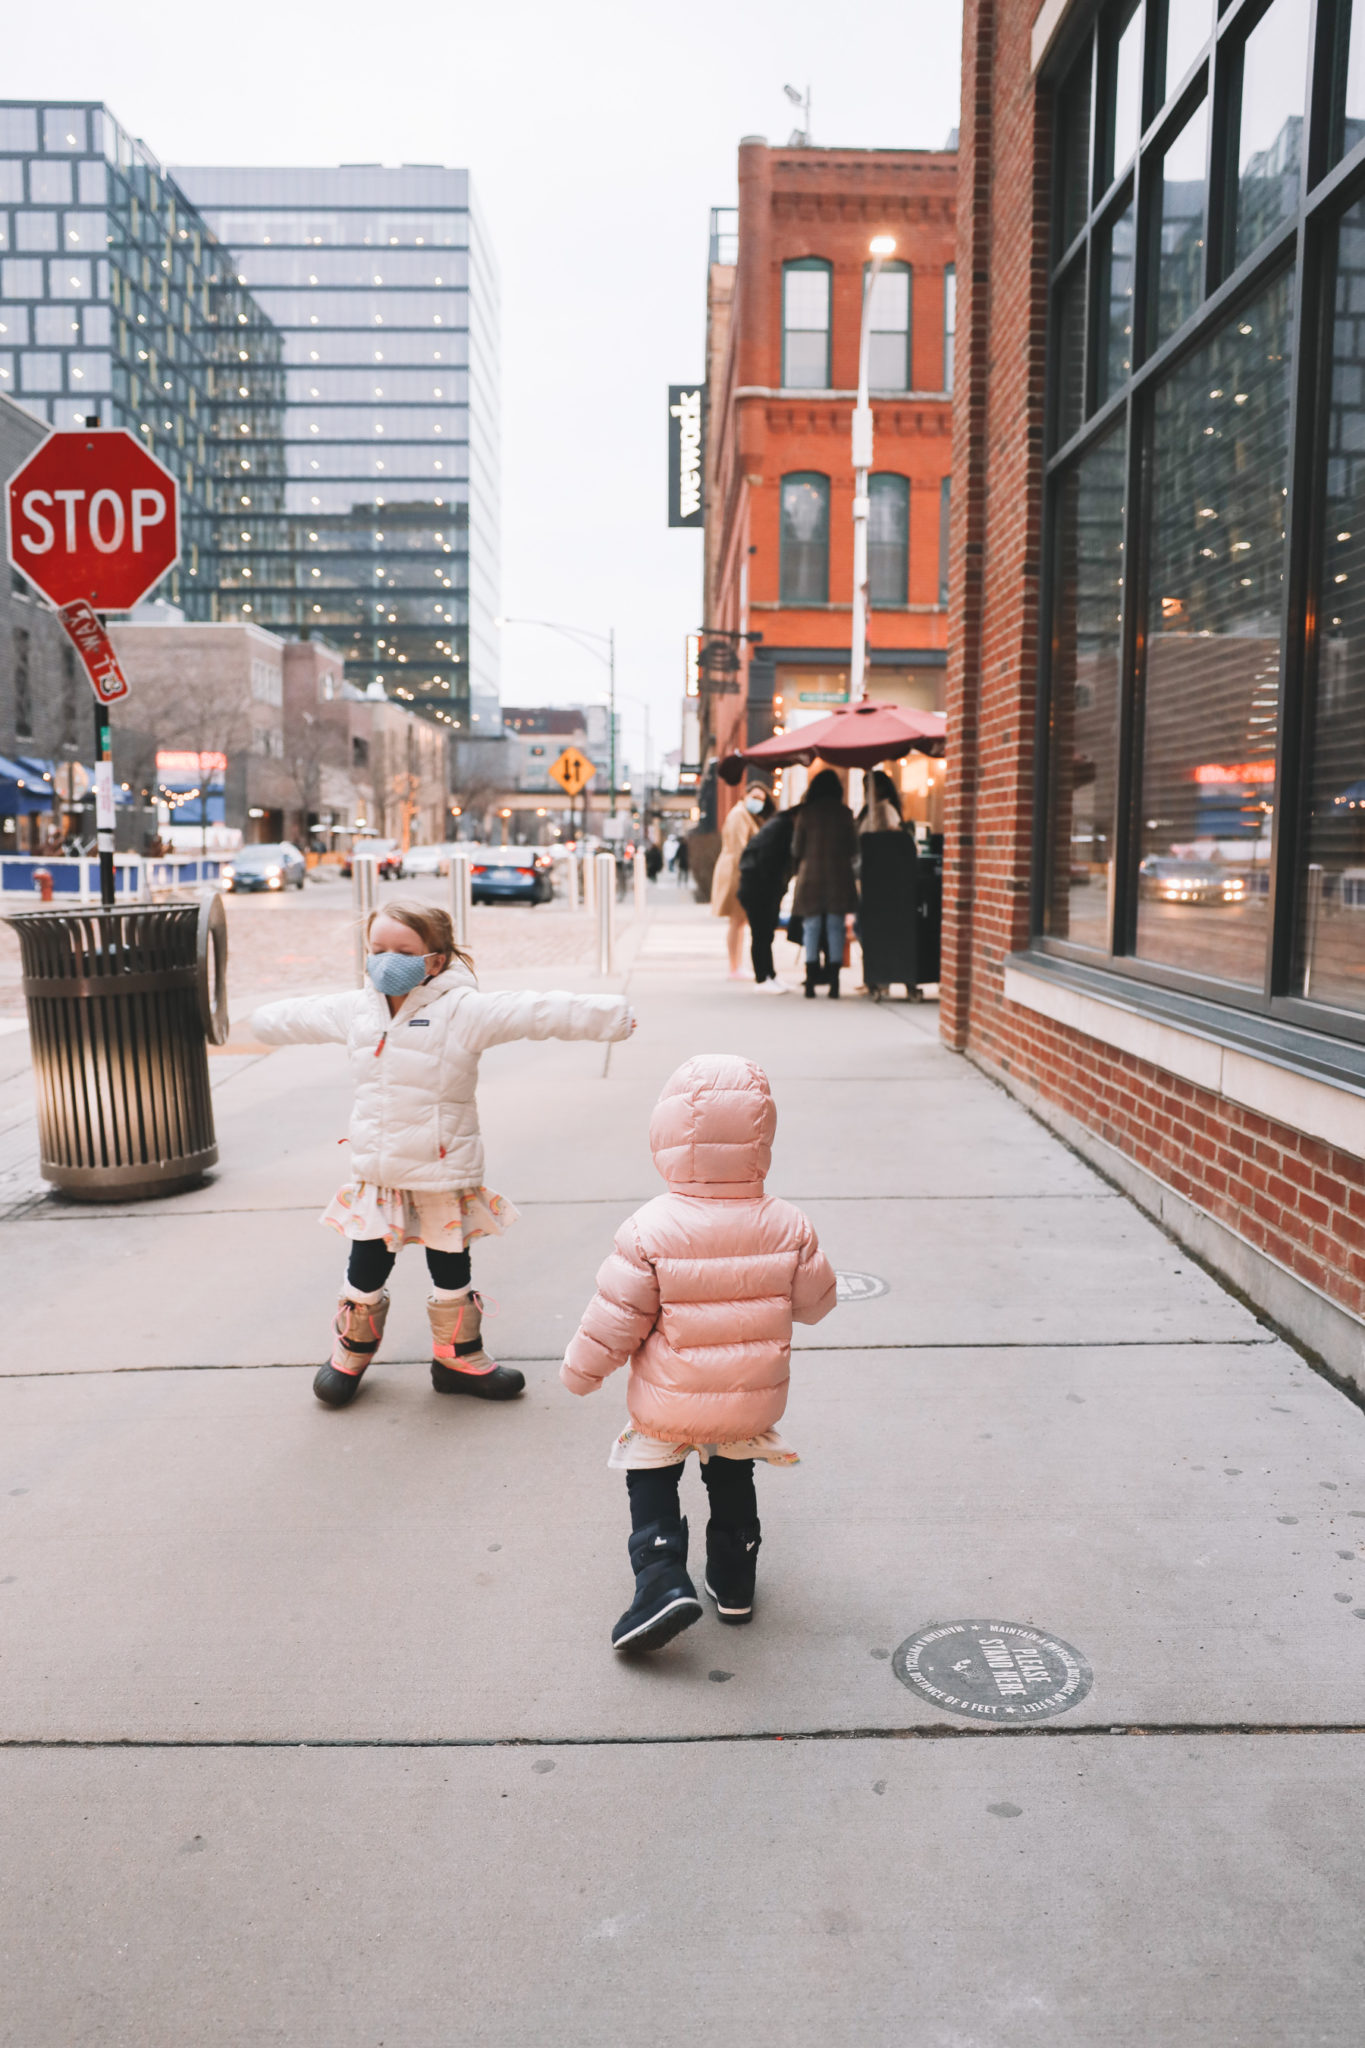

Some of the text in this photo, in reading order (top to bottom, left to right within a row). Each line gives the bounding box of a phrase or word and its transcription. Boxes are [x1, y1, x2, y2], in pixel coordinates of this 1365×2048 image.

[20, 488, 166, 554] STOP
[70, 609, 100, 652] WAY
[919, 1624, 966, 1644] MAINTAIN
[989, 1624, 1041, 1641] MAINTAIN
[904, 1644, 924, 1671] PHYSICAL
[1011, 1648, 1052, 1683] PLEASE
[1042, 1641, 1078, 1668] PHYSICAL
[978, 1638, 1027, 1696] STAND HERE
[908, 1671, 947, 1699] DISTANCE
[1058, 1668, 1081, 1696] DISTANCE
[944, 1695, 961, 1705] OF
[960, 1701, 969, 1709] 6
[970, 1703, 998, 1714] FEET
[1022, 1700, 1049, 1713] FEET
[1044, 1698, 1056, 1706] 6
[1052, 1693, 1067, 1703] OF
